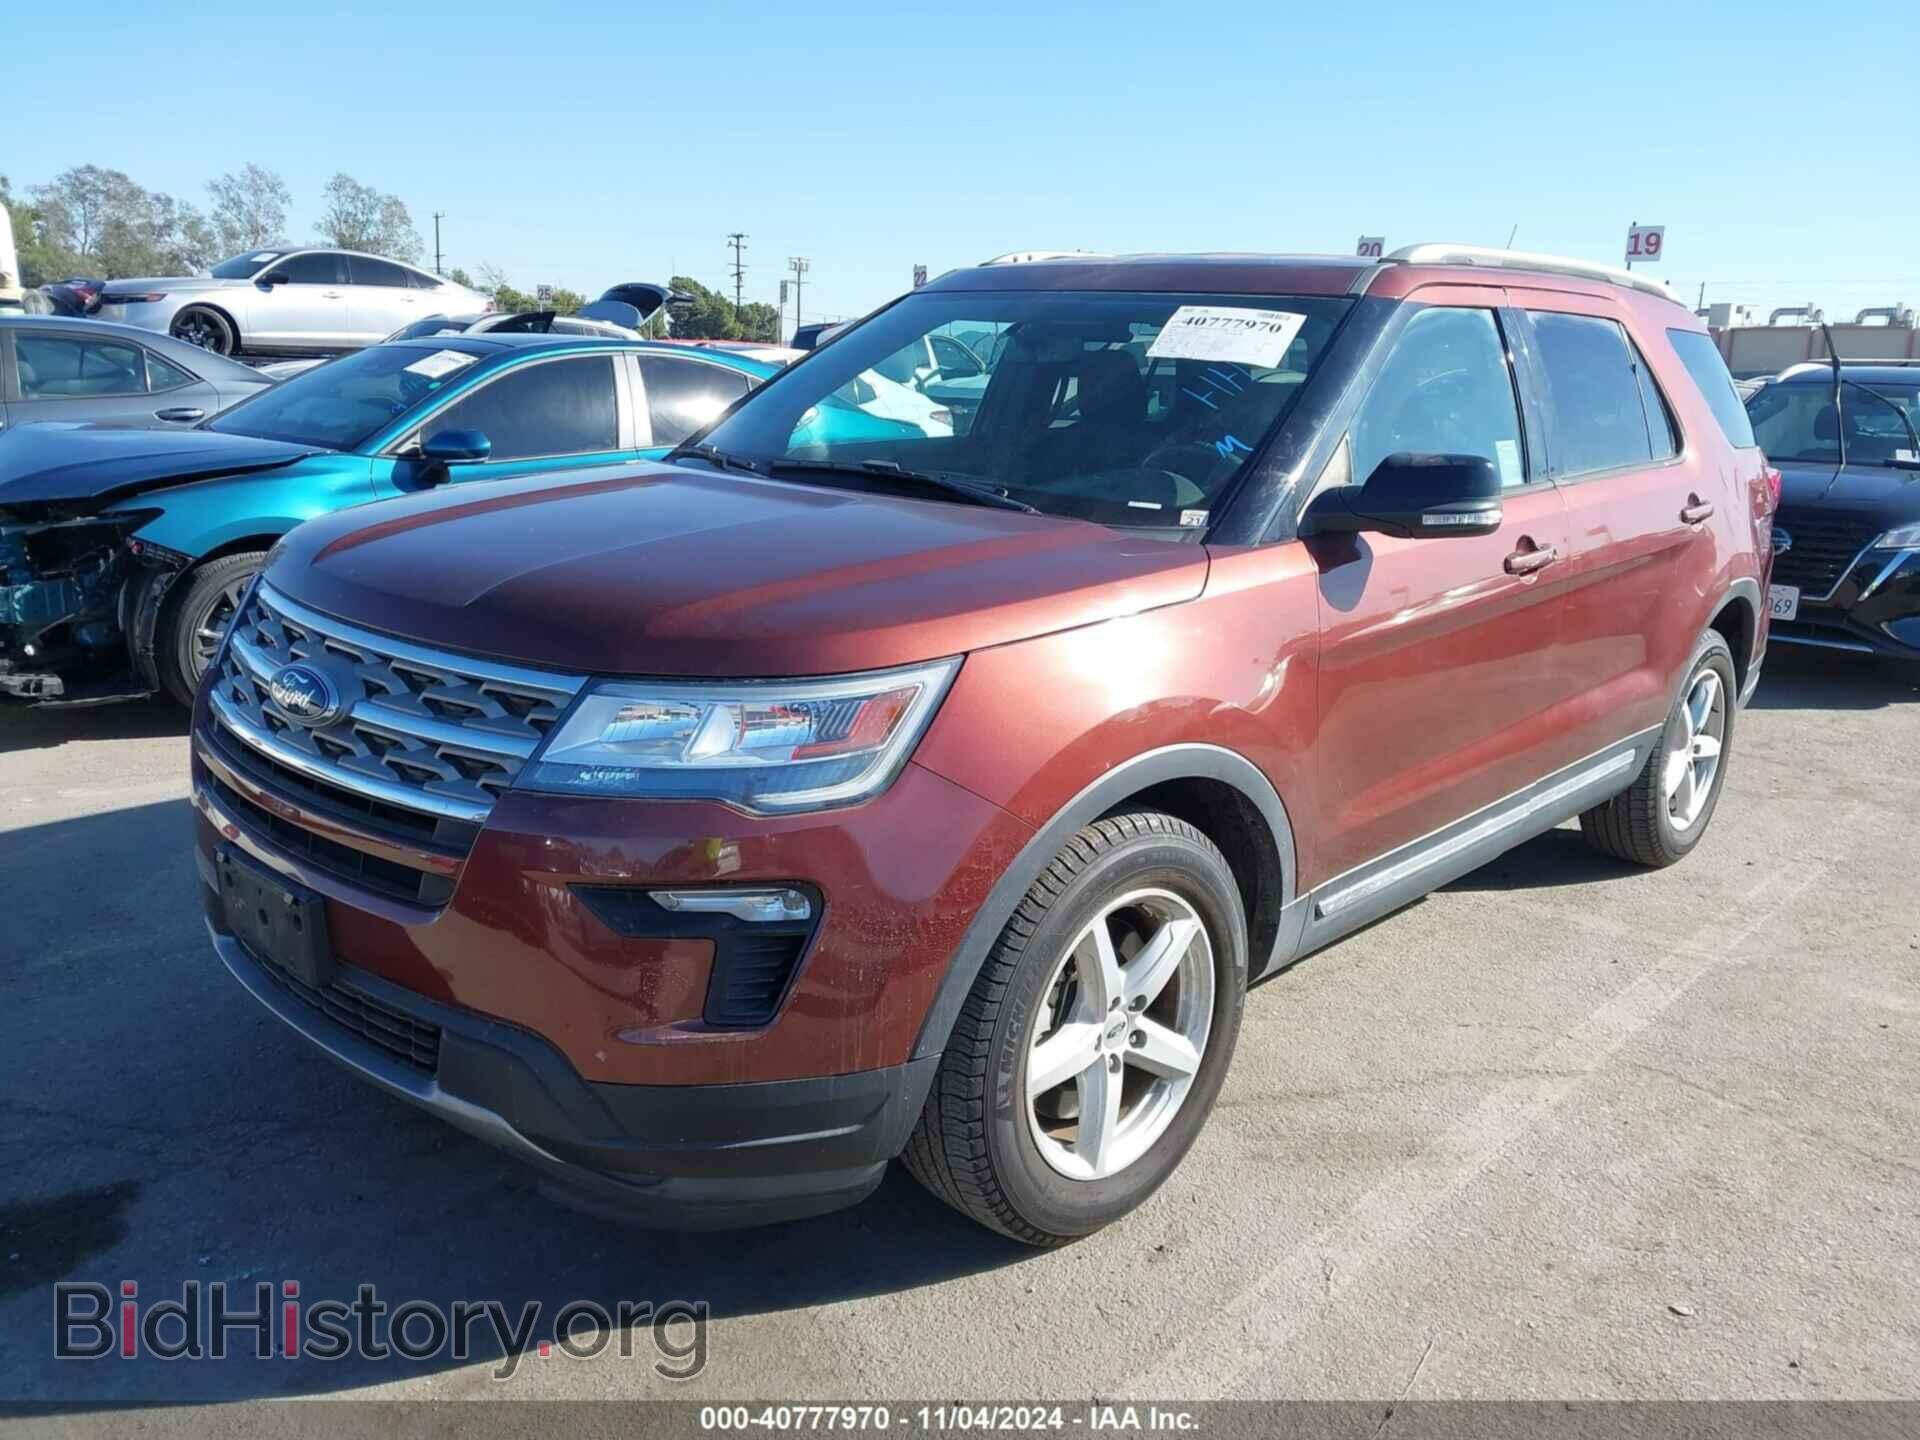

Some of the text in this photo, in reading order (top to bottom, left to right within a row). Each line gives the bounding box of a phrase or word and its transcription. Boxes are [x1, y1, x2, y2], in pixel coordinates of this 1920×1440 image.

[1628, 232, 1661, 255] 19
[538, 288, 551, 301] 25
[1182, 316, 1282, 334] 40777970
[277, 671, 316, 708] Ford
